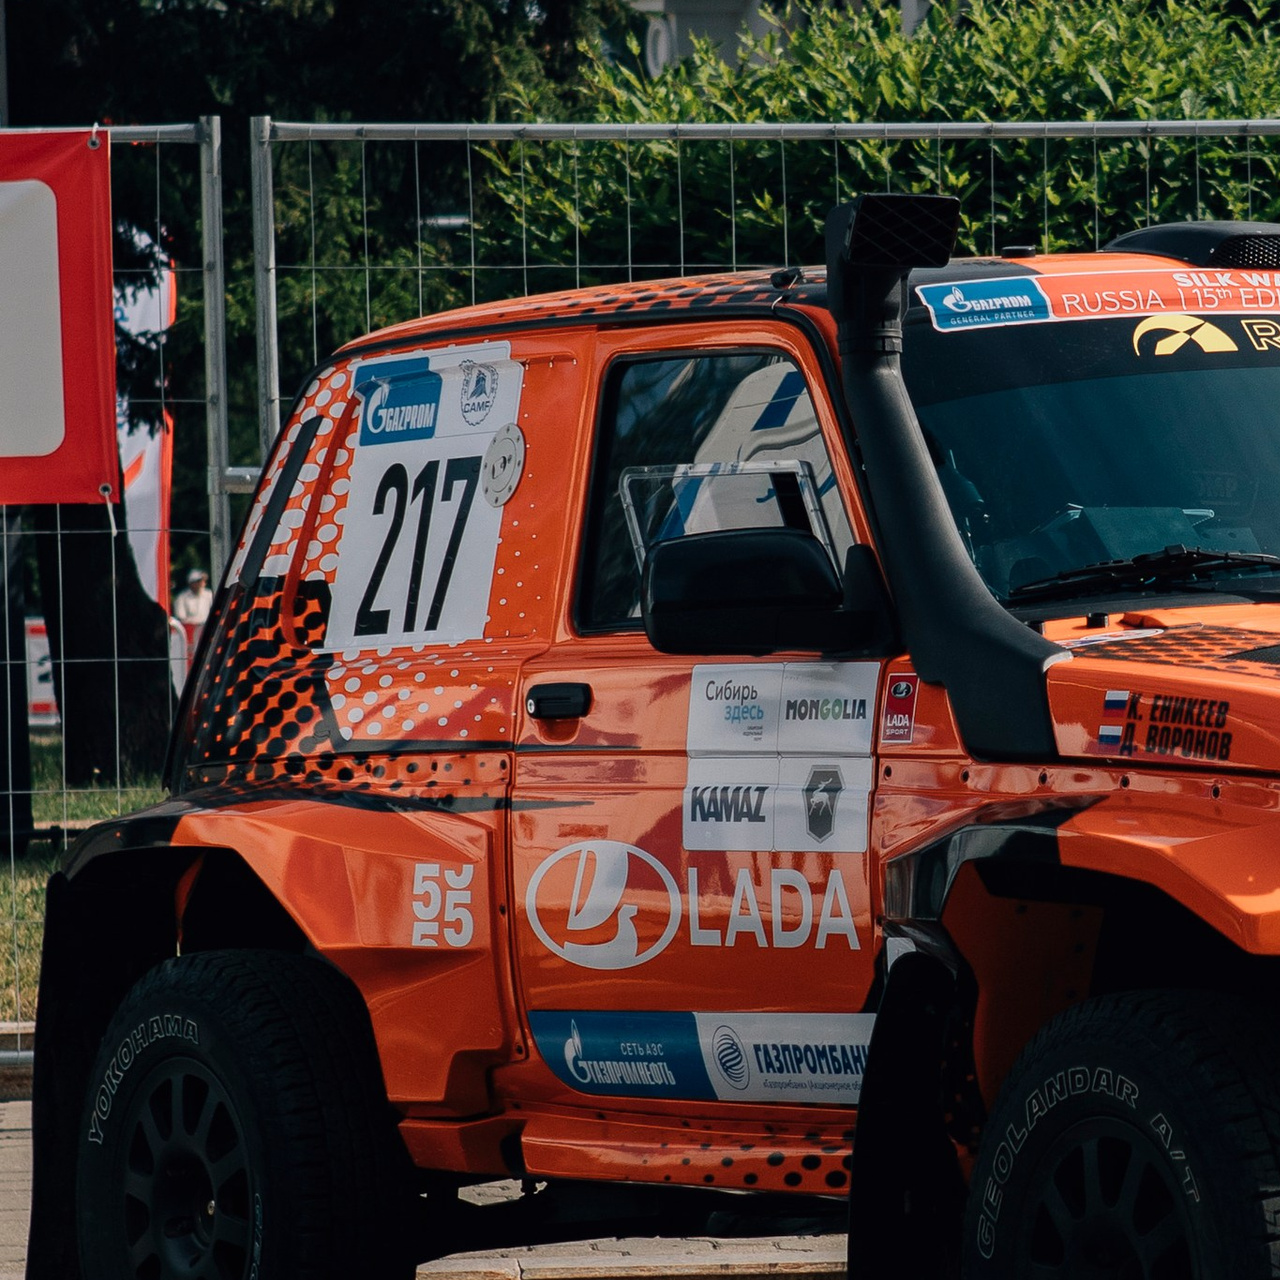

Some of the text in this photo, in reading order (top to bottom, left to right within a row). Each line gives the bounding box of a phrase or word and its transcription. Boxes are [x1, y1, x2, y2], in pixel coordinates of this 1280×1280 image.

[1172, 273, 1232, 289] SILK
[971, 295, 1032, 311] GAZPROM
[1061, 289, 1166, 315] RUSSIA
[1199, 287, 1232, 309] 15th
[950, 310, 1036, 325] GENERAL PARTNER
[385, 402, 437, 433] GAZPROM
[463, 400, 491, 414] CAMF
[353, 455, 483, 637] 217
[705, 679, 759, 705] Сибирь
[724, 704, 765, 725] здесь
[785, 698, 867, 721] MONGOLIA
[886, 714, 910, 727] LADA
[1150, 694, 1230, 729] ЕНИКЕЕВ
[885, 728, 910, 736] SPORT
[1145, 726, 1233, 761] ВОРОНОВ
[690, 786, 770, 823] KAMAZ
[687, 868, 861, 950] LADA
[620, 1042, 664, 1056] СЕТЬ АЗС
[753, 1043, 870, 1076] ГАЗПРОМБАН
[88, 1014, 200, 1145] YOKOHAMA
[587, 1060, 677, 1086] ГАЗПРОМНЕФТЬ
[977, 1066, 1139, 1260] GEOLANDAR
